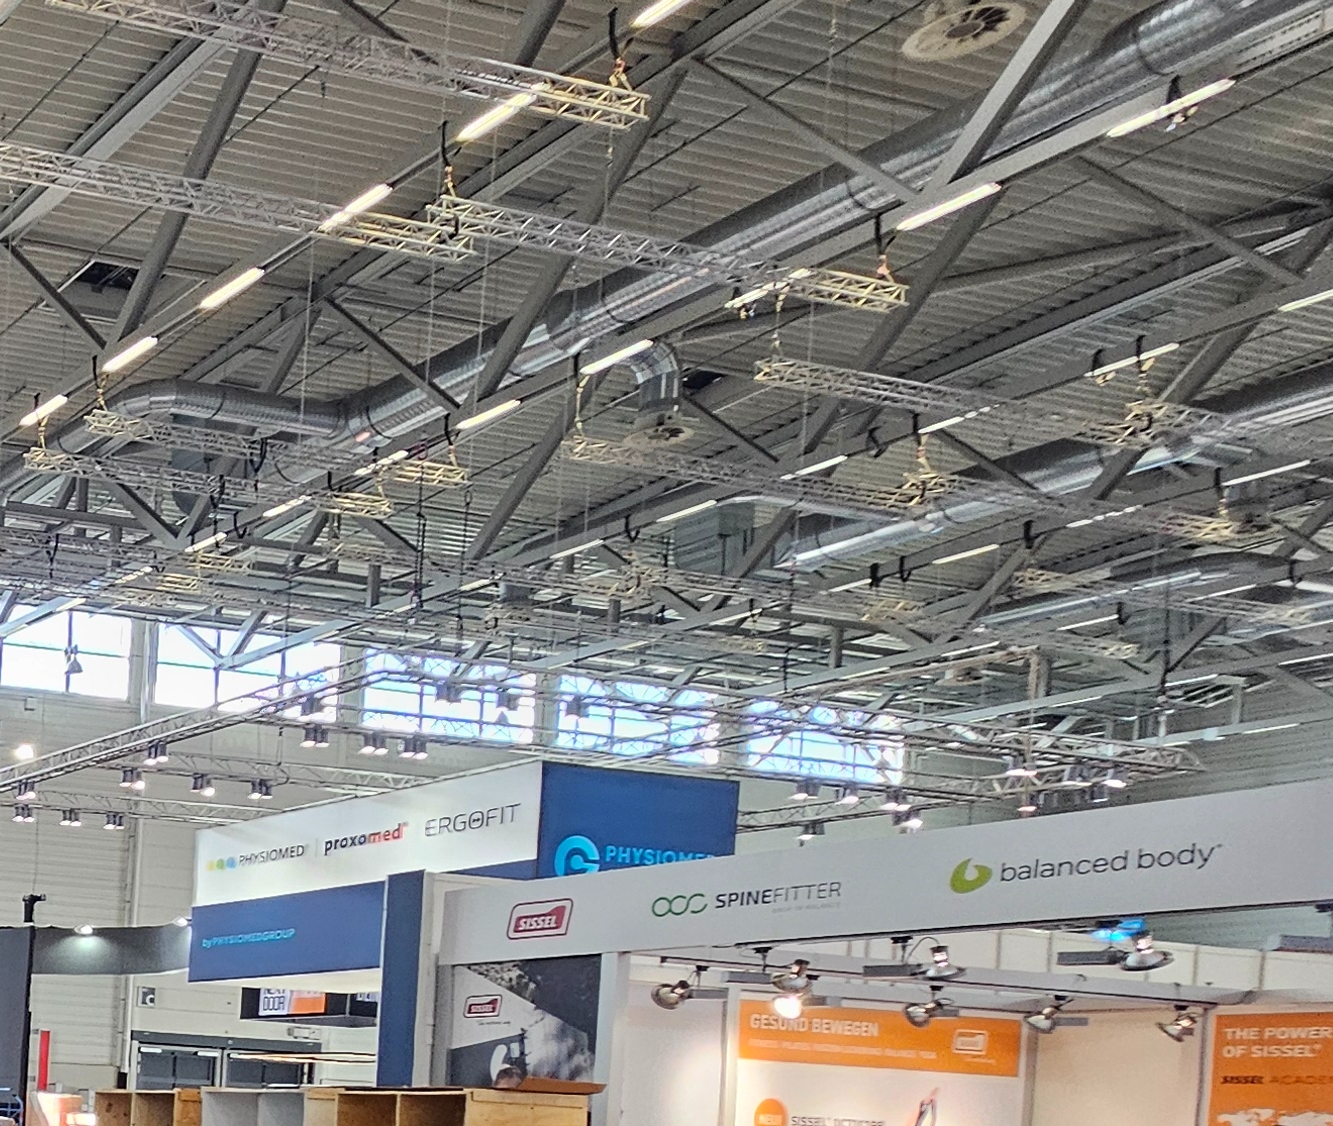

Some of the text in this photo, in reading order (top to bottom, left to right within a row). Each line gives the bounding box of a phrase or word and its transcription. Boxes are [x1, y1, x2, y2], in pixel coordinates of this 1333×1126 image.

[425, 803, 522, 837] ERGOFIT
[239, 844, 306, 867] PHYSIOMED
[605, 845, 714, 865] PHYSIOM
[1000, 843, 1217, 882] balanced body
[715, 881, 842, 909] SPINEFITTER
[517, 915, 558, 931] SISSEL
[812, 1019, 879, 1037] BEWEGEN
[1224, 1026, 1333, 1040] THE POWER
[1222, 1045, 1247, 1058] OF
